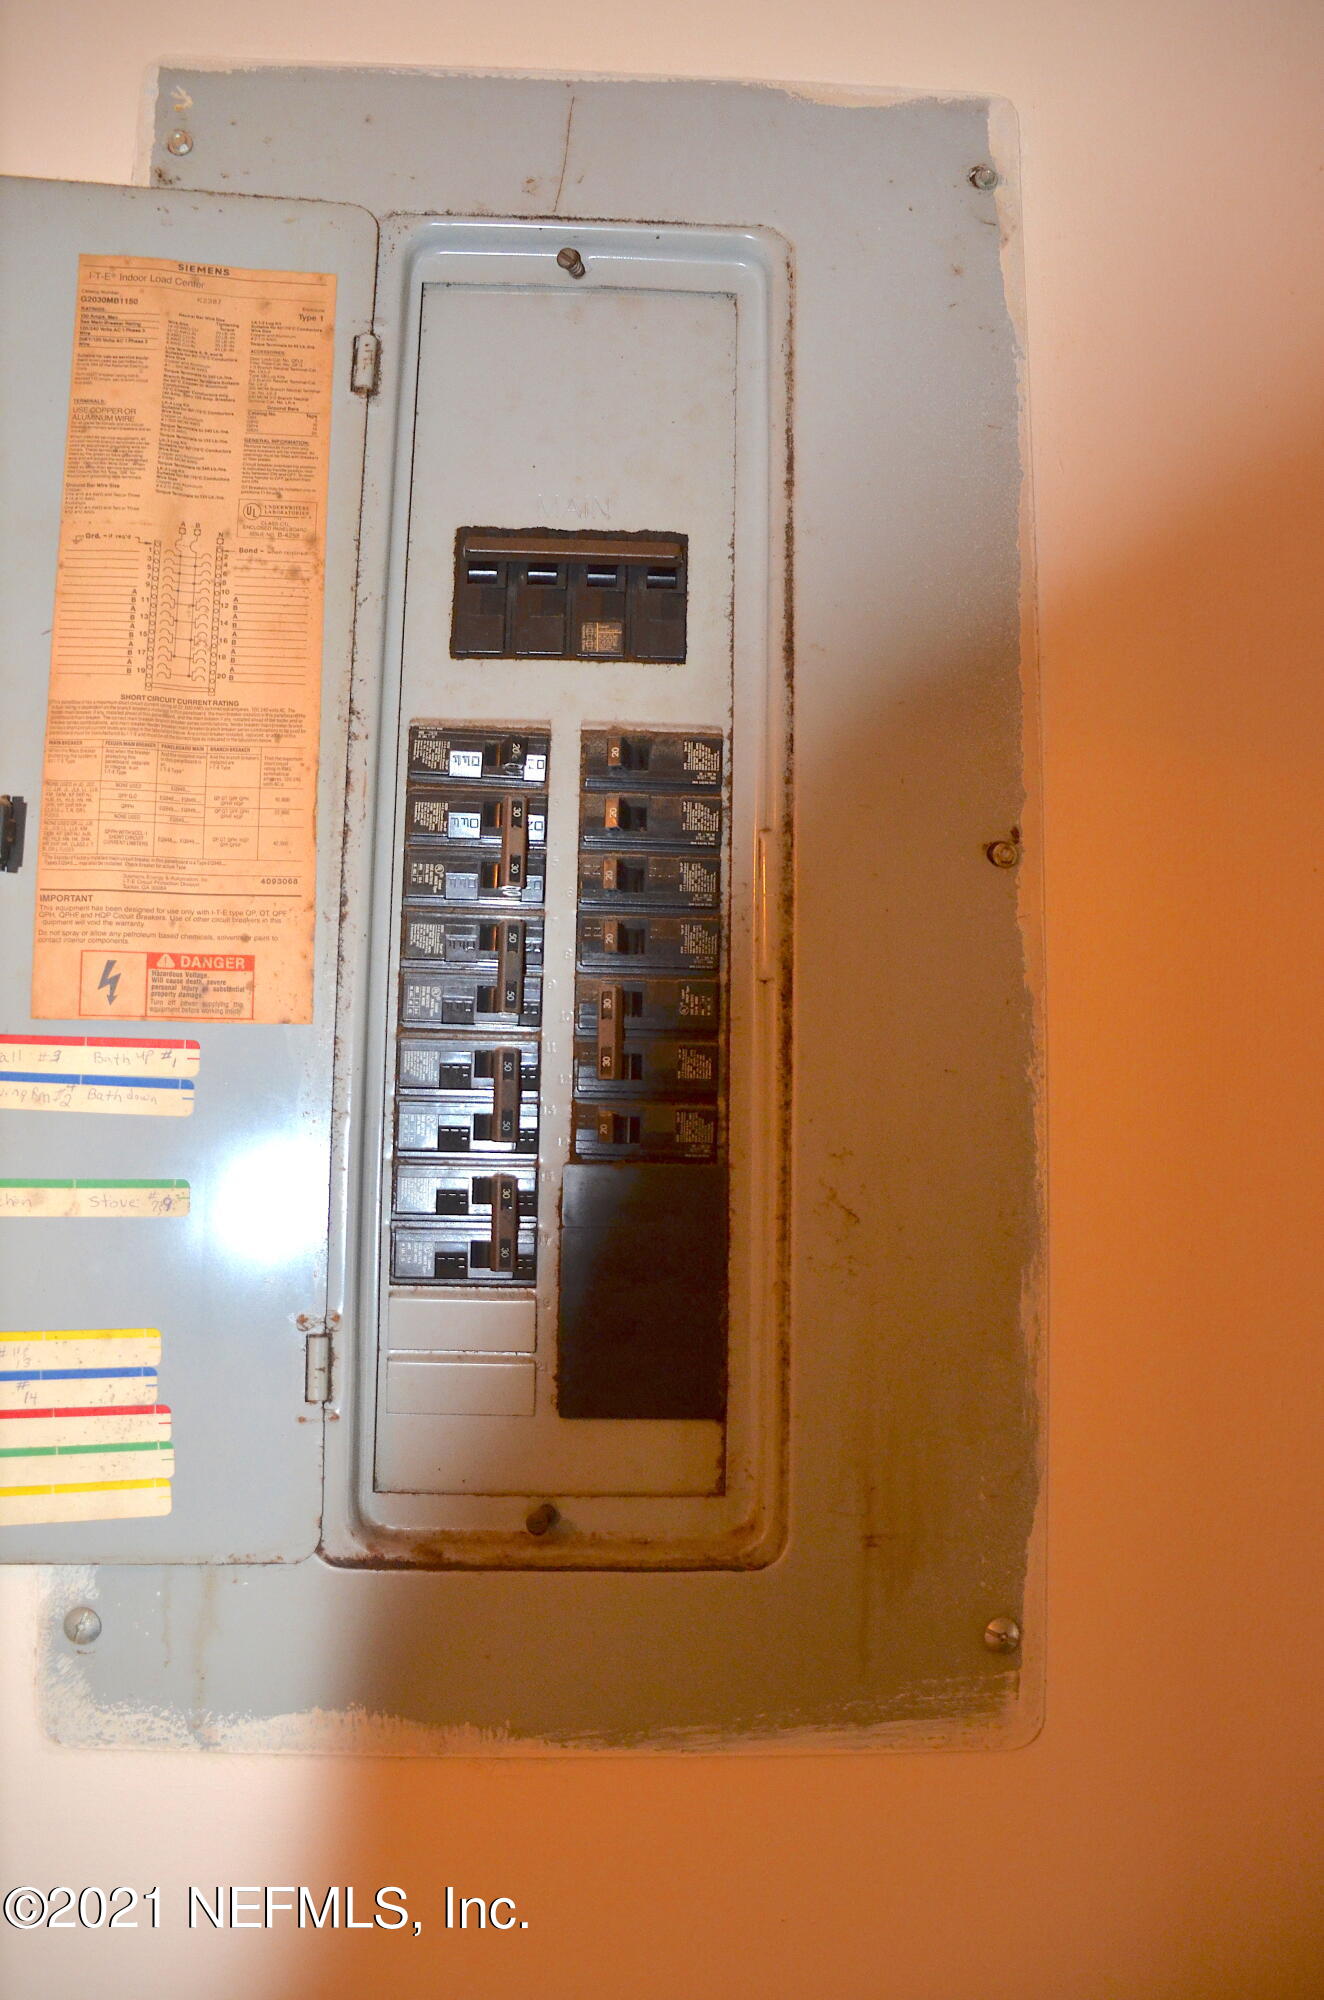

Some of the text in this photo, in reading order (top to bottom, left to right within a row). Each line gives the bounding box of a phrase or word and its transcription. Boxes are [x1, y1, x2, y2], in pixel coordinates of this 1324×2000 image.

[178, 264, 230, 276] SIEMENS
[120, 273, 146, 282] Indoor
[150, 274, 171, 284] Load
[175, 277, 205, 289] Center
[299, 314, 316, 322] Type
[612, 747, 619, 758] 20
[512, 807, 521, 818] 30
[610, 808, 617, 818] 20
[511, 863, 519, 873] 30
[606, 870, 613, 880] 20
[509, 932, 517, 943] 50
[180, 955, 245, 969] DANGER
[507, 991, 515, 1001] 50
[603, 998, 612, 1009] 30
[94, 1052, 130, 1065] Bath
[602, 1056, 611, 1068] 30
[504, 1062, 512, 1071] 50
[88, 1088, 122, 1102] Bath
[127, 1088, 158, 1104] down
[502, 1121, 510, 1131] 50
[600, 1123, 608, 1134] 20
[502, 1189, 510, 1199] 30
[88, 1194, 138, 1208] Stove
[501, 1247, 510, 1258] 30
